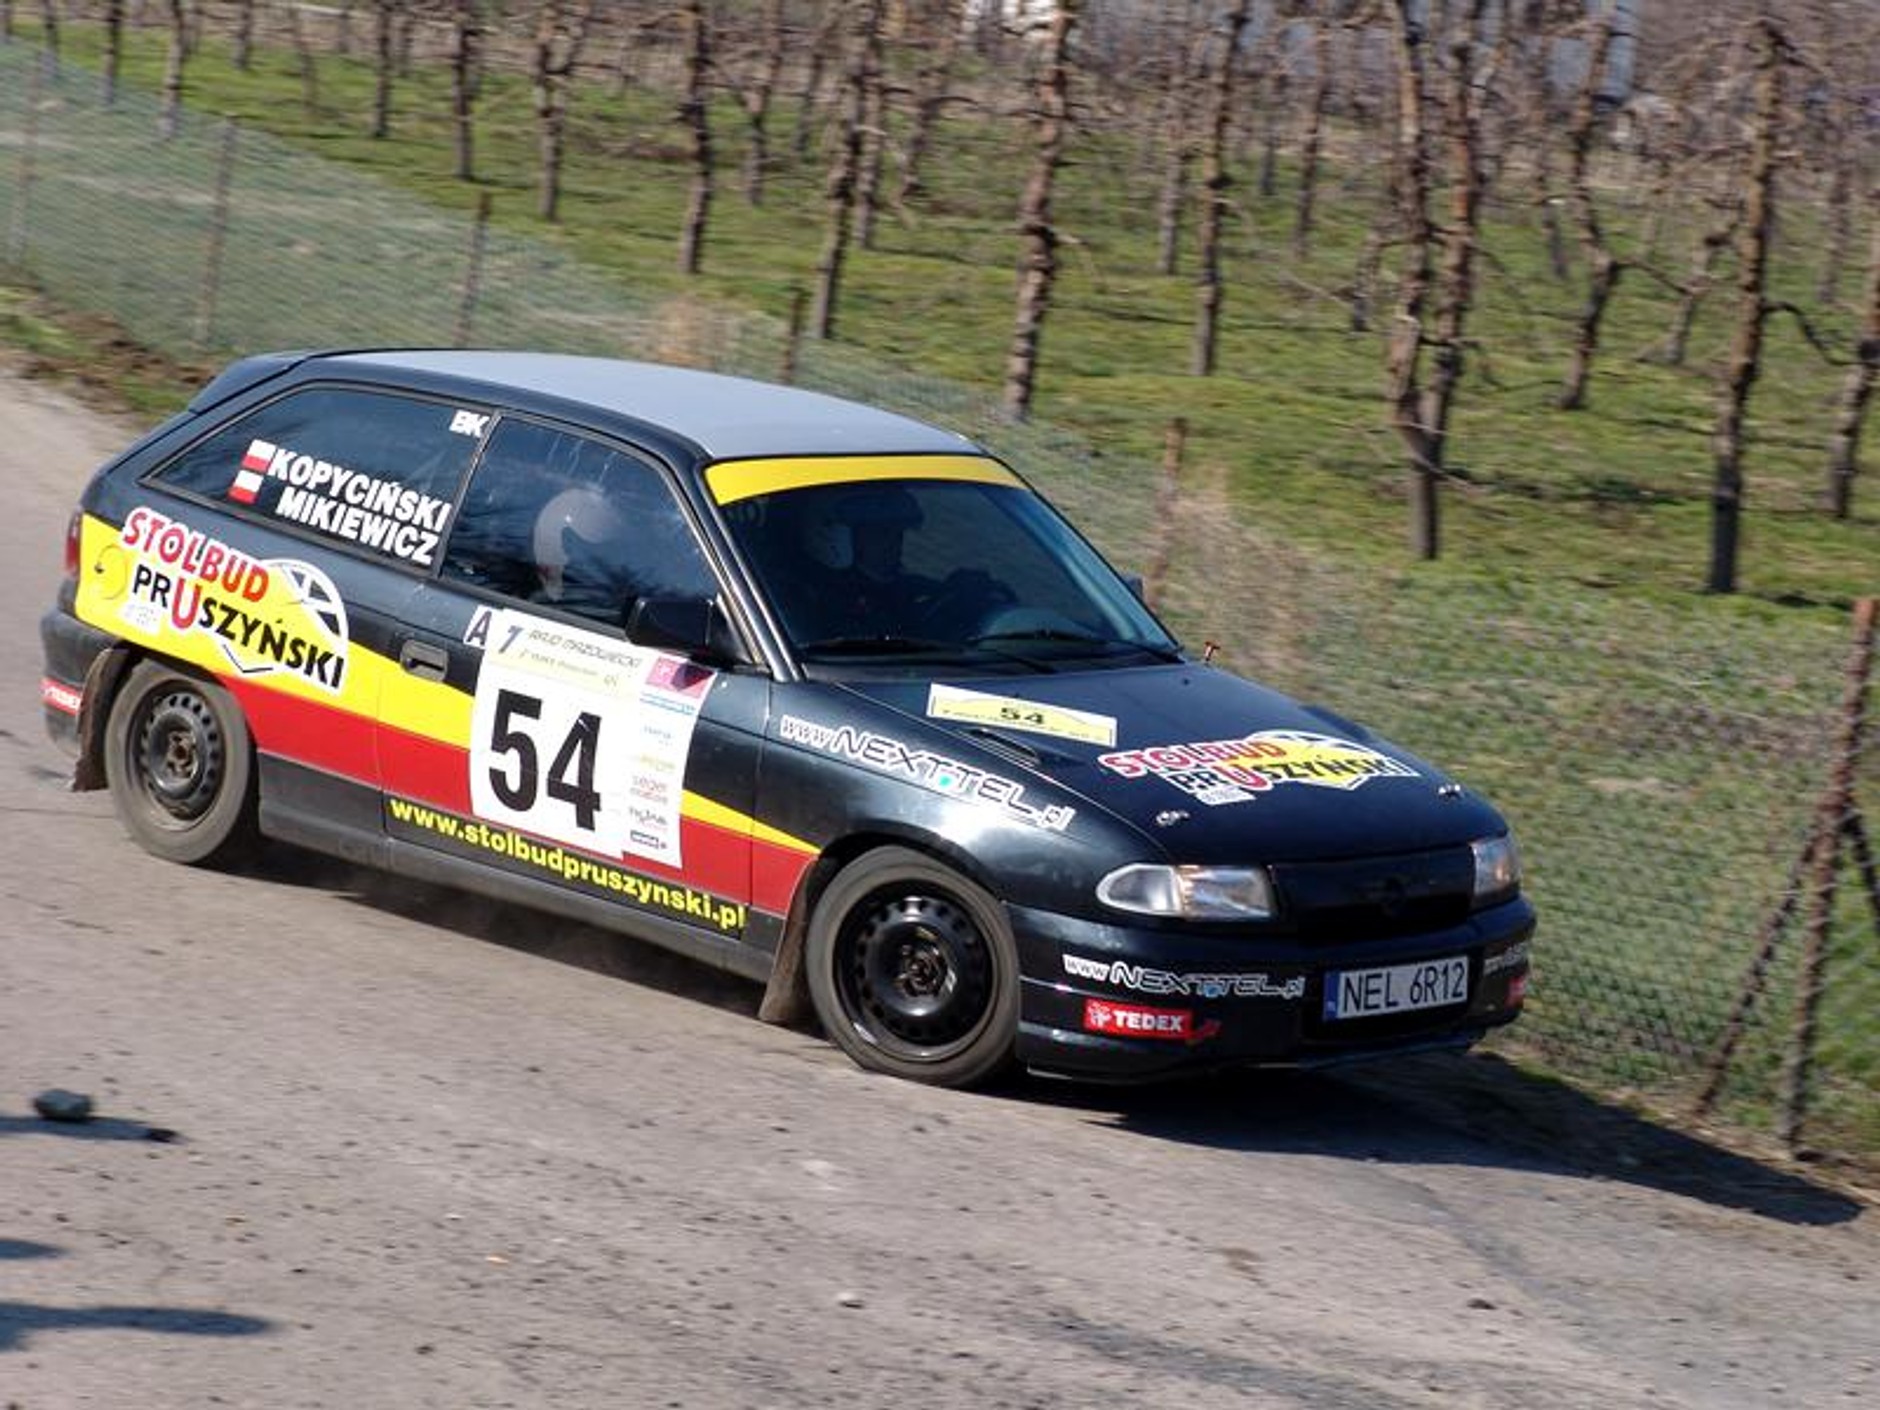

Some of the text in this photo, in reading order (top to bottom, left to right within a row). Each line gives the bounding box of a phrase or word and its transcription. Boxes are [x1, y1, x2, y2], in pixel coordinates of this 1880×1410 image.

[450, 410, 490, 438] BK
[267, 448, 453, 533] KOPYCIŃSKI
[123, 510, 270, 603] STOLBUD
[275, 486, 440, 566] MIKIEWICZ
[132, 564, 345, 690] PRUSZYŃSKI
[467, 610, 493, 646] A
[1000, 706, 1044, 725] 54
[488, 688, 603, 832] 54
[1104, 740, 1287, 775] STOLBUD
[389, 798, 745, 929] www.stolbudpruszynski.pl
[1342, 960, 1466, 1013] NEL 6R12
[1113, 1010, 1184, 1031] TEDEX
